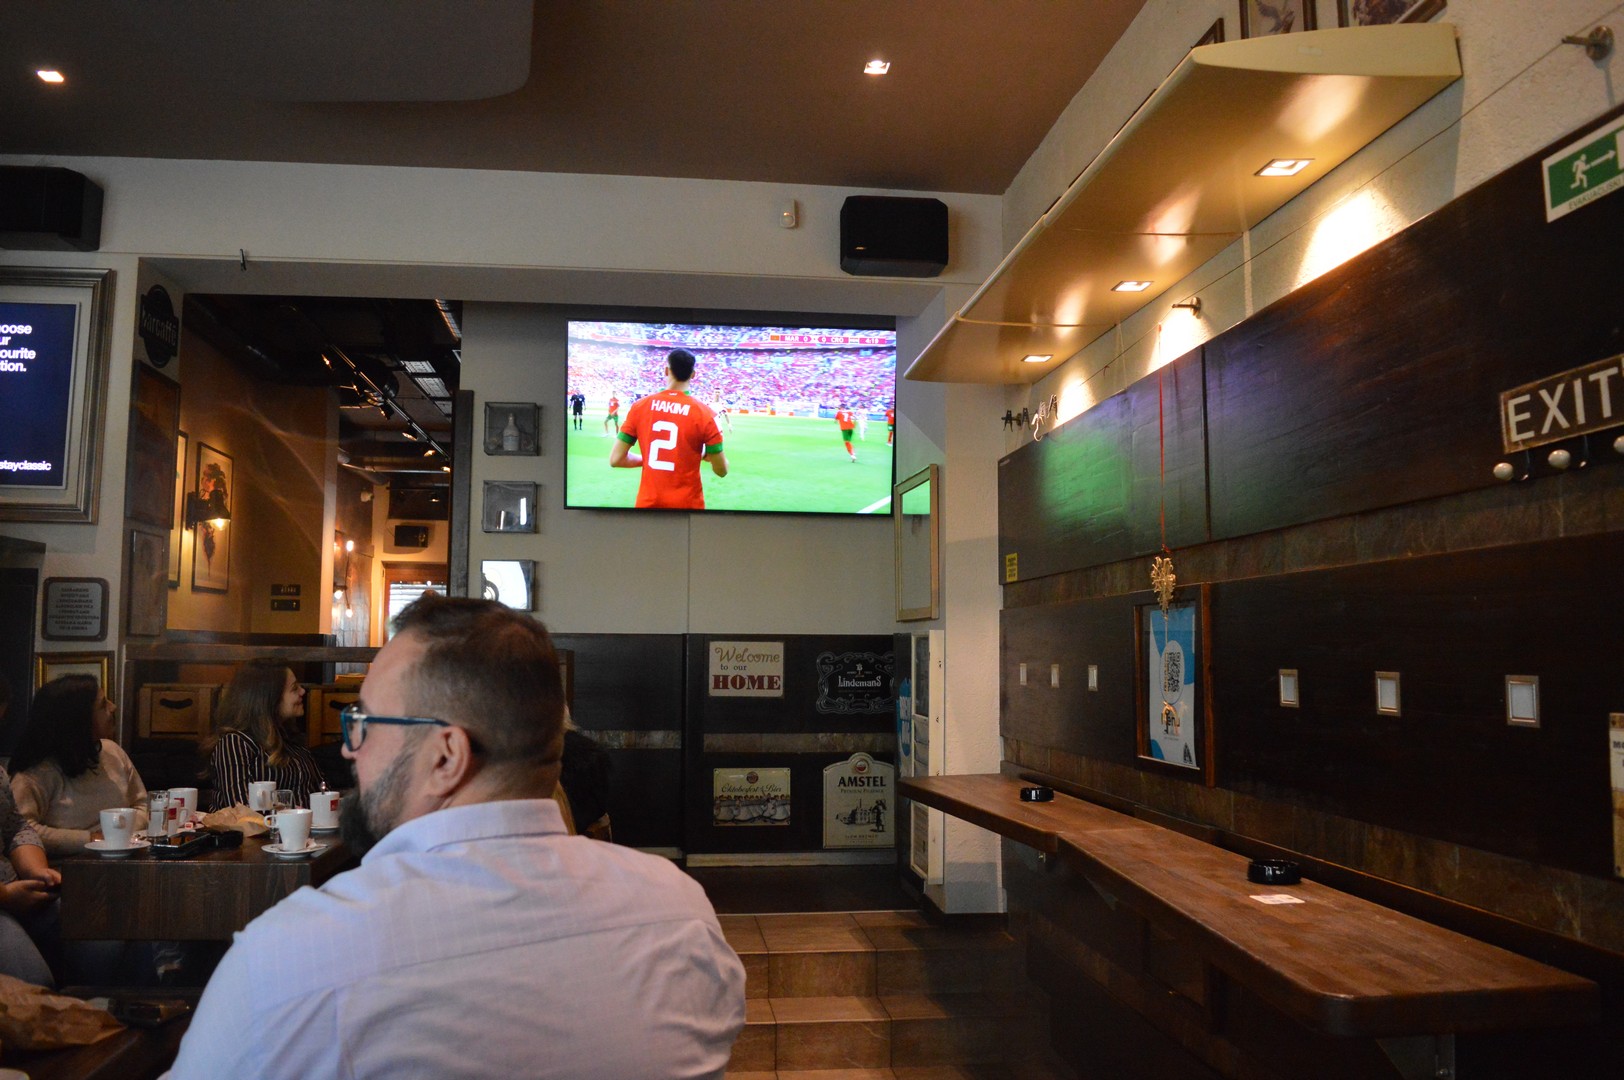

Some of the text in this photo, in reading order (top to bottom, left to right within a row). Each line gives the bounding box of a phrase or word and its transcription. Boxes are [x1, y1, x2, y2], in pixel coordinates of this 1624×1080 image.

[0, 324, 32, 334] oose
[1508, 367, 1619, 442] EXIT
[648, 420, 679, 472] 2
[715, 646, 780, 663] Welcome
[712, 674, 781, 690] HOME
[838, 776, 886, 787] AMSTEL
